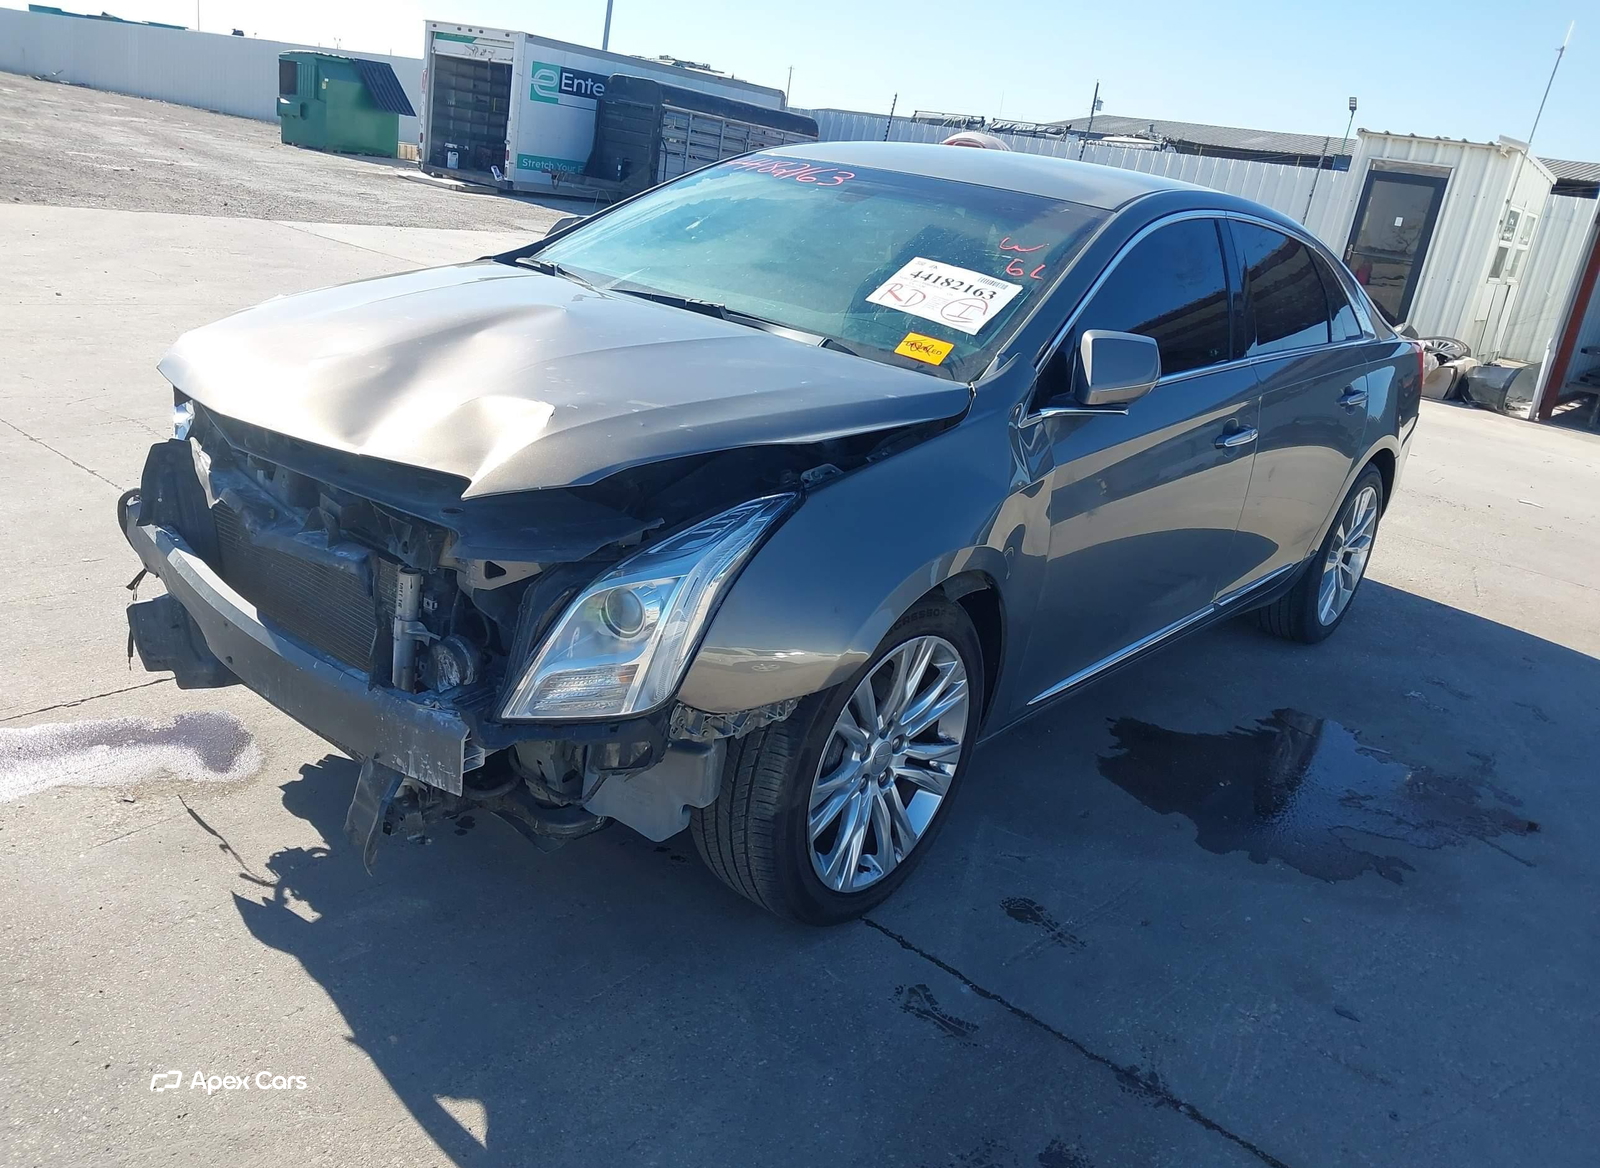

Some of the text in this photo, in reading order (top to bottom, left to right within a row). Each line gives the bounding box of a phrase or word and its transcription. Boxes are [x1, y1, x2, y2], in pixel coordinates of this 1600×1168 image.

[522, 158, 554, 170] Stretch
[556, 163, 576, 173] Your
[910, 270, 997, 301] 44182163
